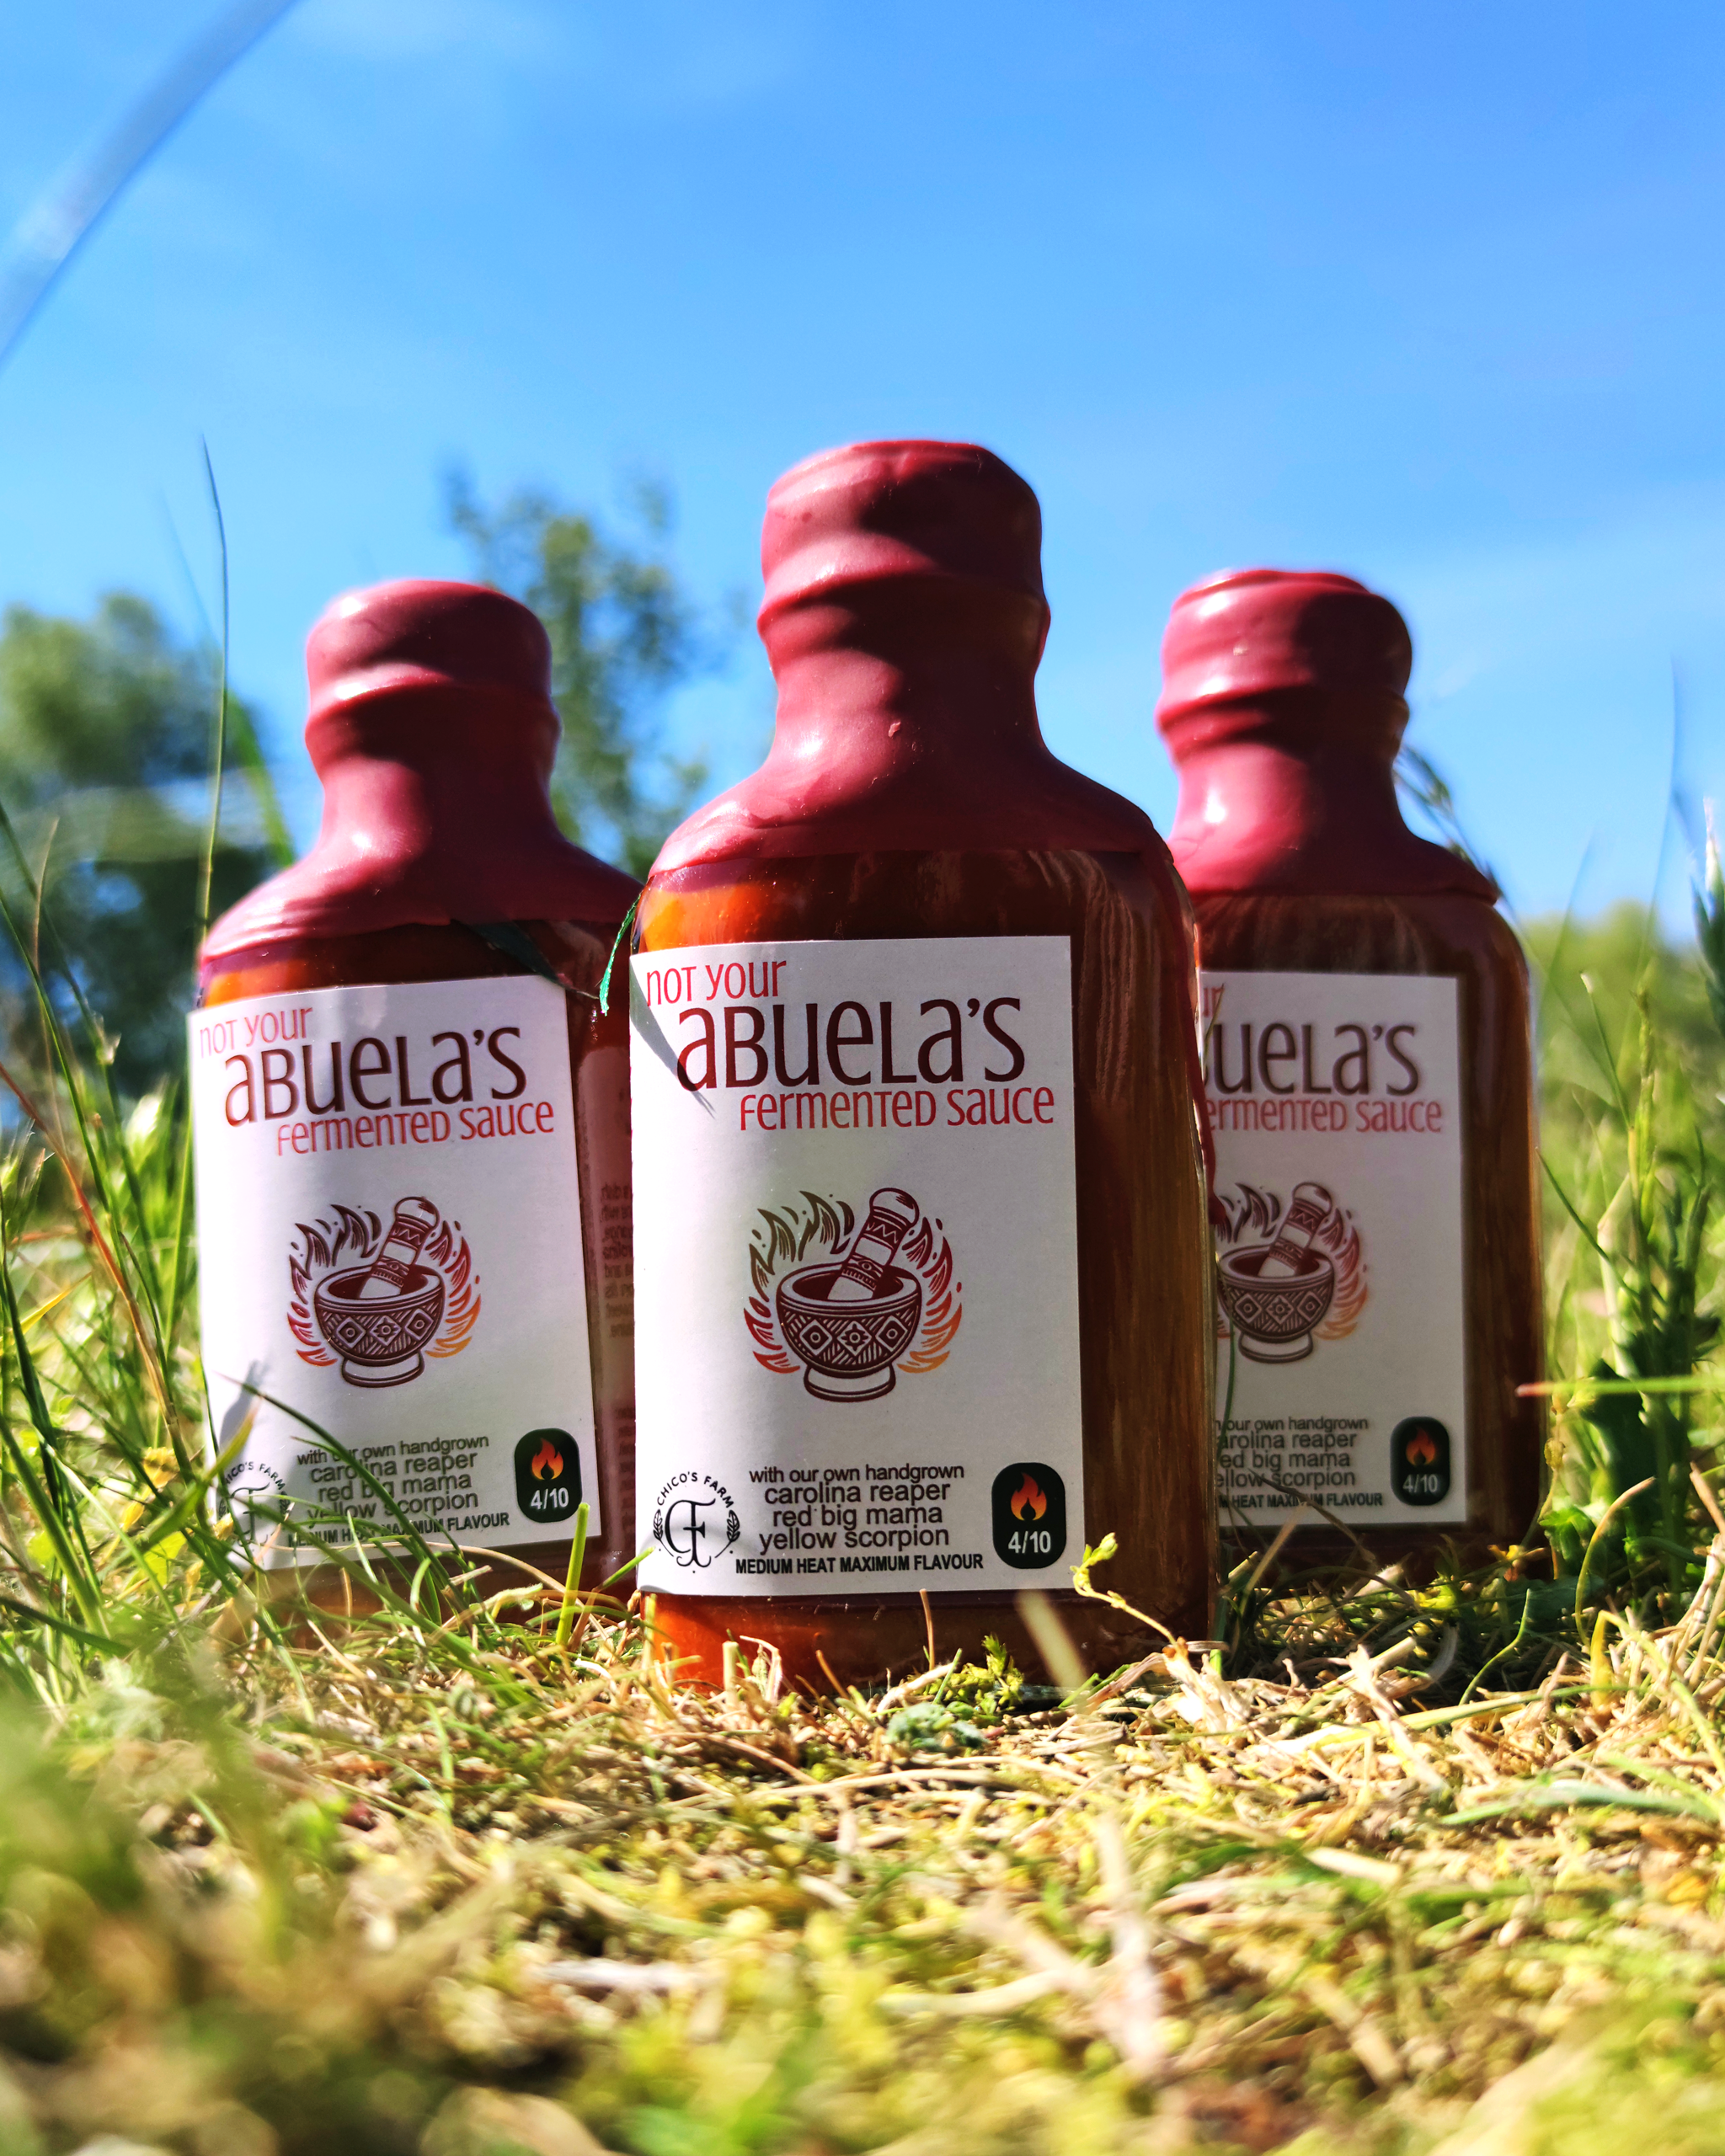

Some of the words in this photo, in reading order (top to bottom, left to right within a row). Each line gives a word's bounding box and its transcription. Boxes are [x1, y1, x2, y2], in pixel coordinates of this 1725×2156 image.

[948, 1086, 1055, 1125] sauce
[461, 1101, 554, 1140] sauce
[1227, 1419, 1251, 1431] our
[1254, 1419, 1284, 1431] own
[1288, 1416, 1369, 1434] handgrown
[297, 1449, 327, 1465] with
[362, 1445, 396, 1460] own
[400, 1436, 489, 1455] handgrown
[1216, 1430, 1285, 1449] arolina
[1292, 1432, 1357, 1451] reaper
[405, 1452, 478, 1475] reaper
[1220, 1449, 1244, 1469] ed
[1252, 1449, 1281, 1473] big
[1289, 1451, 1350, 1468] mama
[259, 1464, 286, 1490] FARM
[749, 1466, 784, 1483] with
[789, 1469, 819, 1482] our
[824, 1468, 860, 1481] own
[865, 1463, 964, 1484] handgrown
[1216, 1468, 1266, 1488] ellow
[1271, 1466, 1355, 1490] scorpion
[1402, 1474, 1439, 1494] 4/10
[318, 1481, 354, 1502] red
[362, 1478, 394, 1500] bg
[403, 1473, 472, 1494] mama
[531, 1487, 569, 1510] 4/10
[657, 1471, 698, 1506] CHICO'S
[703, 1476, 734, 1508] FARM
[764, 1481, 861, 1505] carolina
[870, 1482, 950, 1506] reaper
[1326, 1492, 1383, 1507] FLAVOUR
[447, 1512, 510, 1532] FLAVOUR
[773, 1504, 812, 1527] red
[821, 1504, 857, 1531] big
[866, 1505, 943, 1525] mama
[759, 1527, 837, 1556] yellow
[844, 1524, 949, 1552] scorpion
[1007, 1531, 1052, 1555] 4/10
[735, 1558, 793, 1574] MEDIUM
[797, 1557, 836, 1573] HEAT
[840, 1555, 910, 1573] MAXIMUM
[914, 1553, 984, 1572] FLAVOUR
